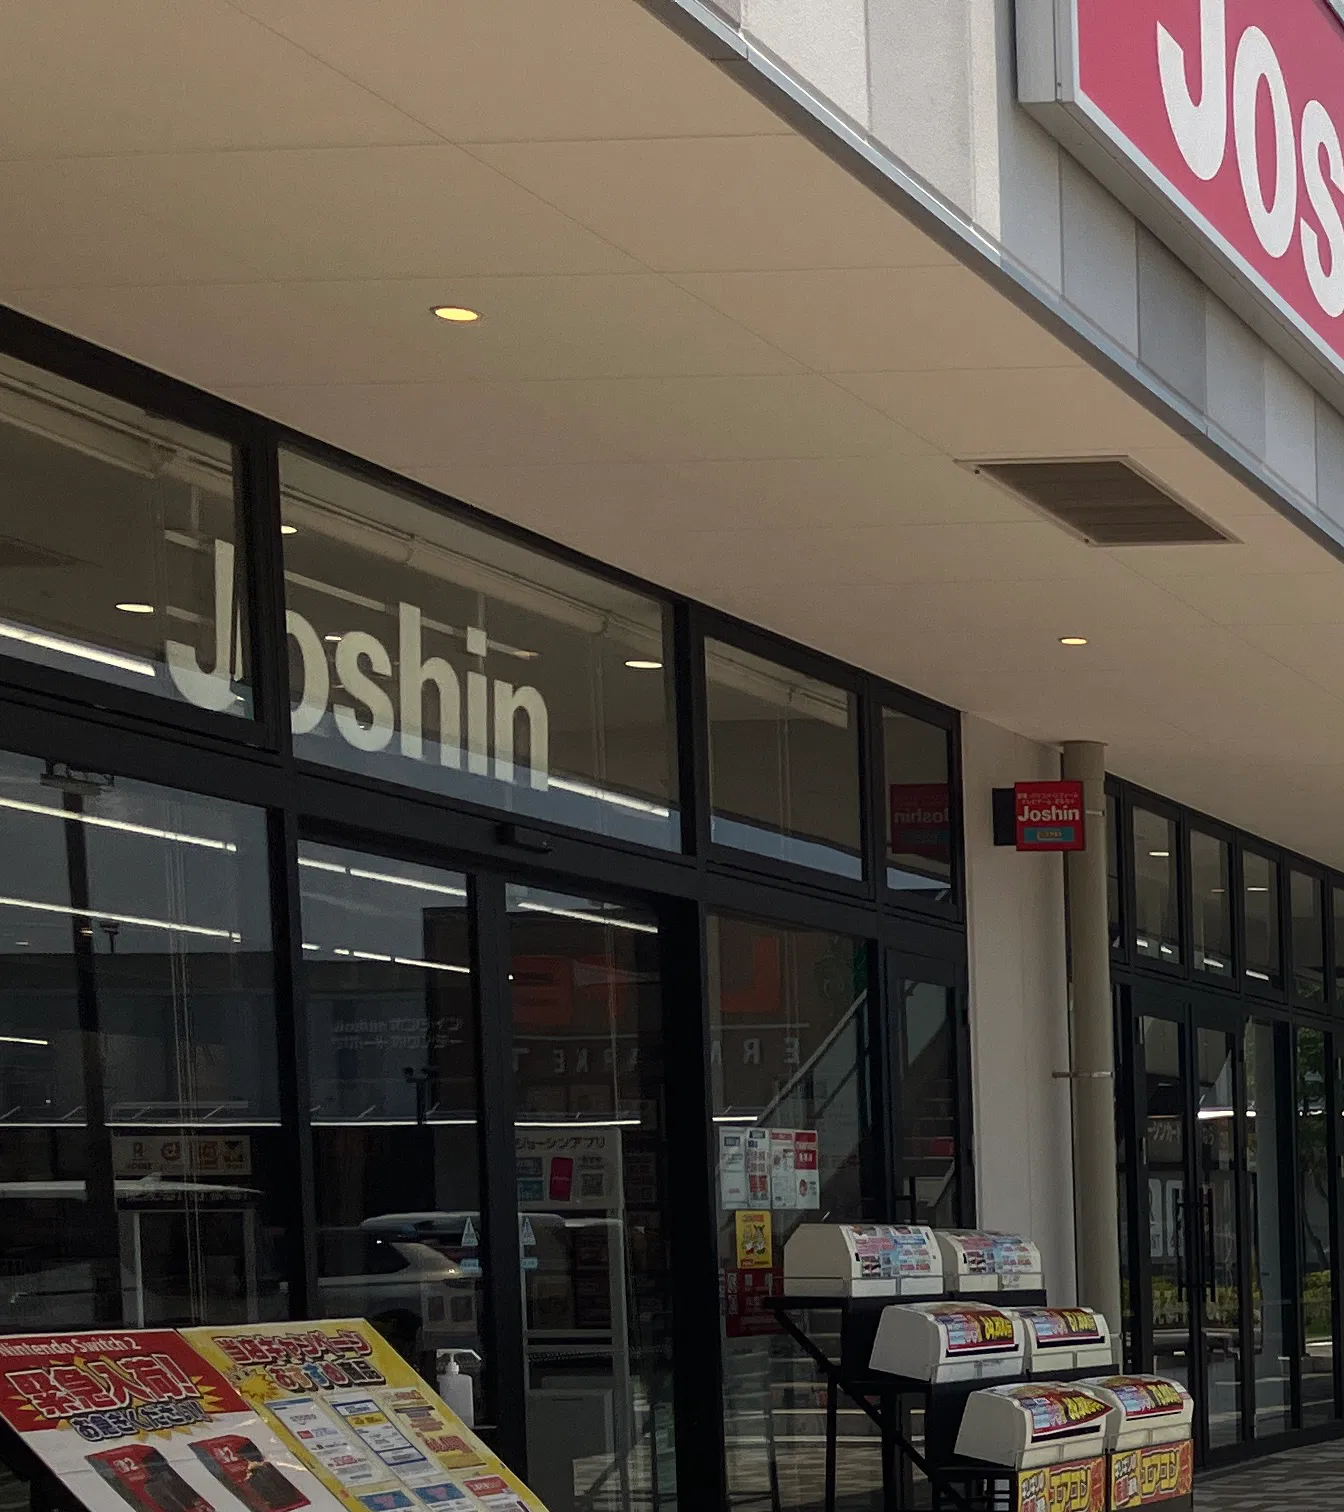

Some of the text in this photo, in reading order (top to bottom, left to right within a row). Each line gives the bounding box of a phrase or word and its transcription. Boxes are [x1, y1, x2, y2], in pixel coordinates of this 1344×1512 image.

[166, 539, 549, 792] Joshin
[1017, 805, 1080, 822] Joshin
[0, 1336, 142, 1357] Nintendo Switch 2
[1141, 1449, 1180, 1496] エアコン
